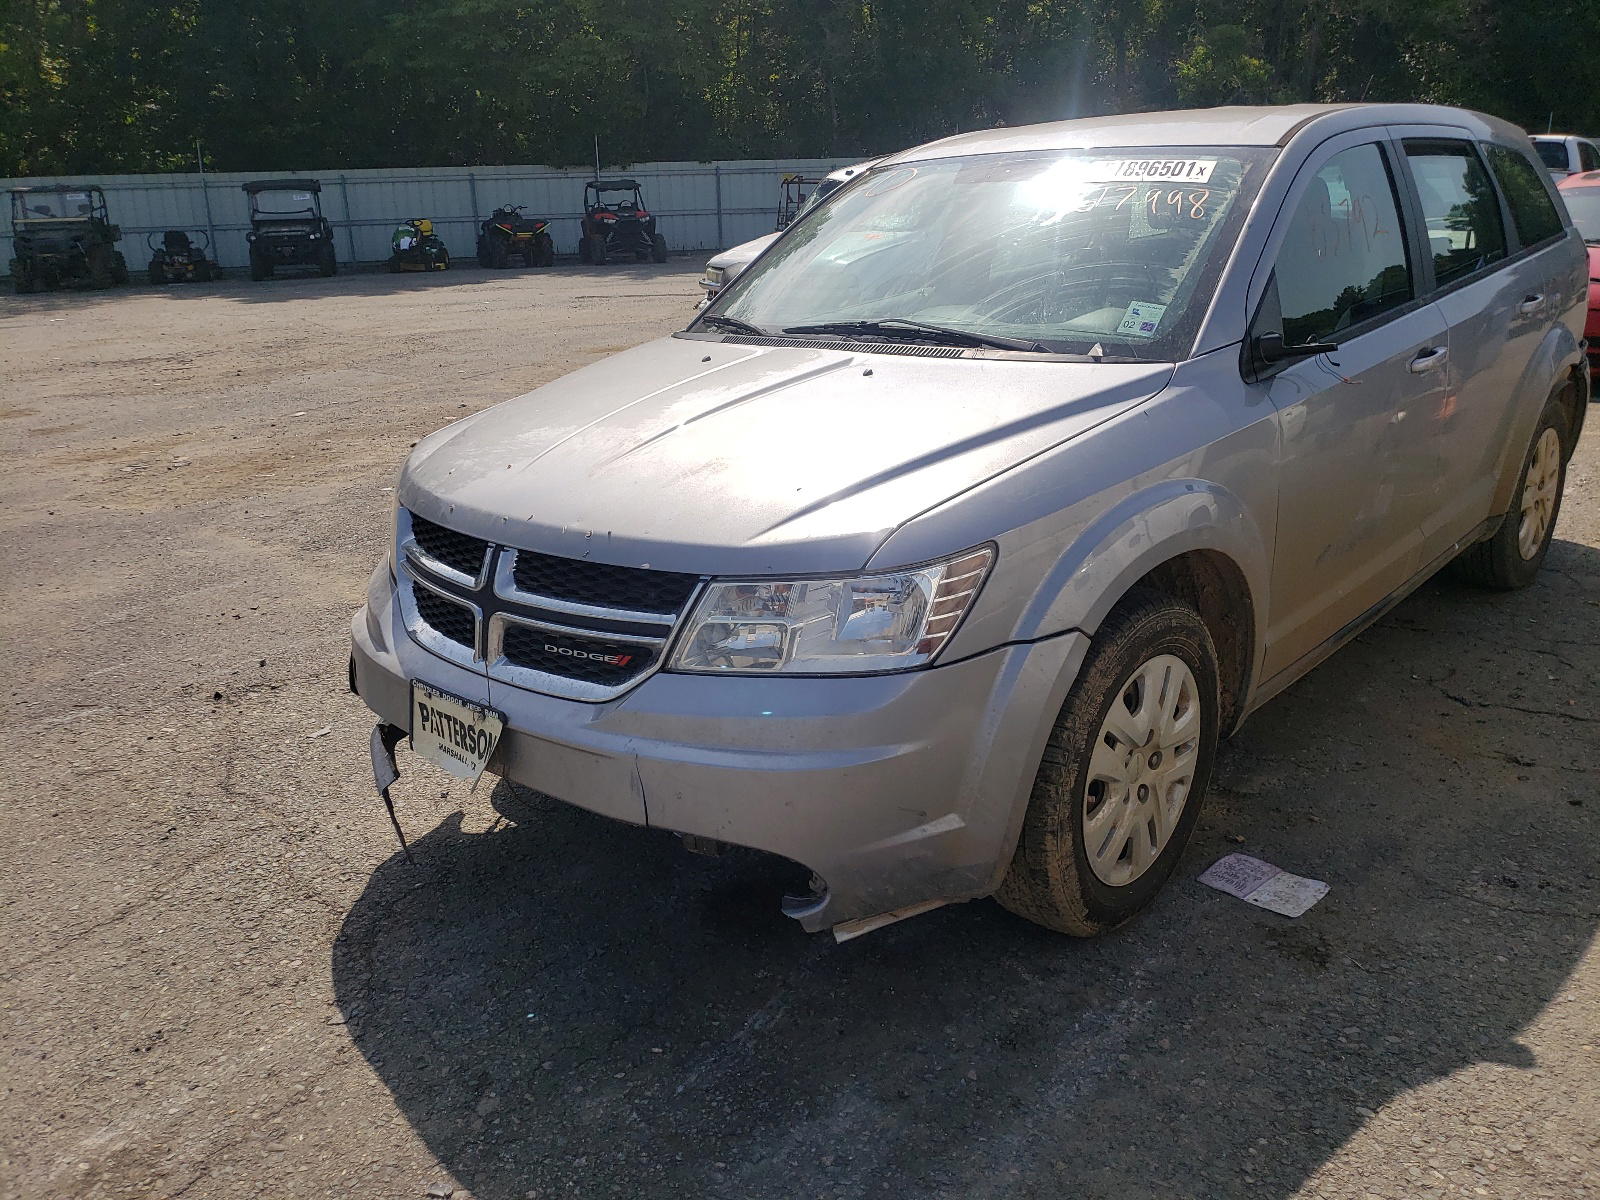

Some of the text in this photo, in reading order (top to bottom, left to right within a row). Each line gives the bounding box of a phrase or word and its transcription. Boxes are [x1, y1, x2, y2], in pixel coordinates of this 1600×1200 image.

[544, 644, 619, 664] DODGE
[412, 680, 441, 697] CHRYSLER
[442, 692, 463, 706] DODGE
[484, 708, 499, 719] RAM
